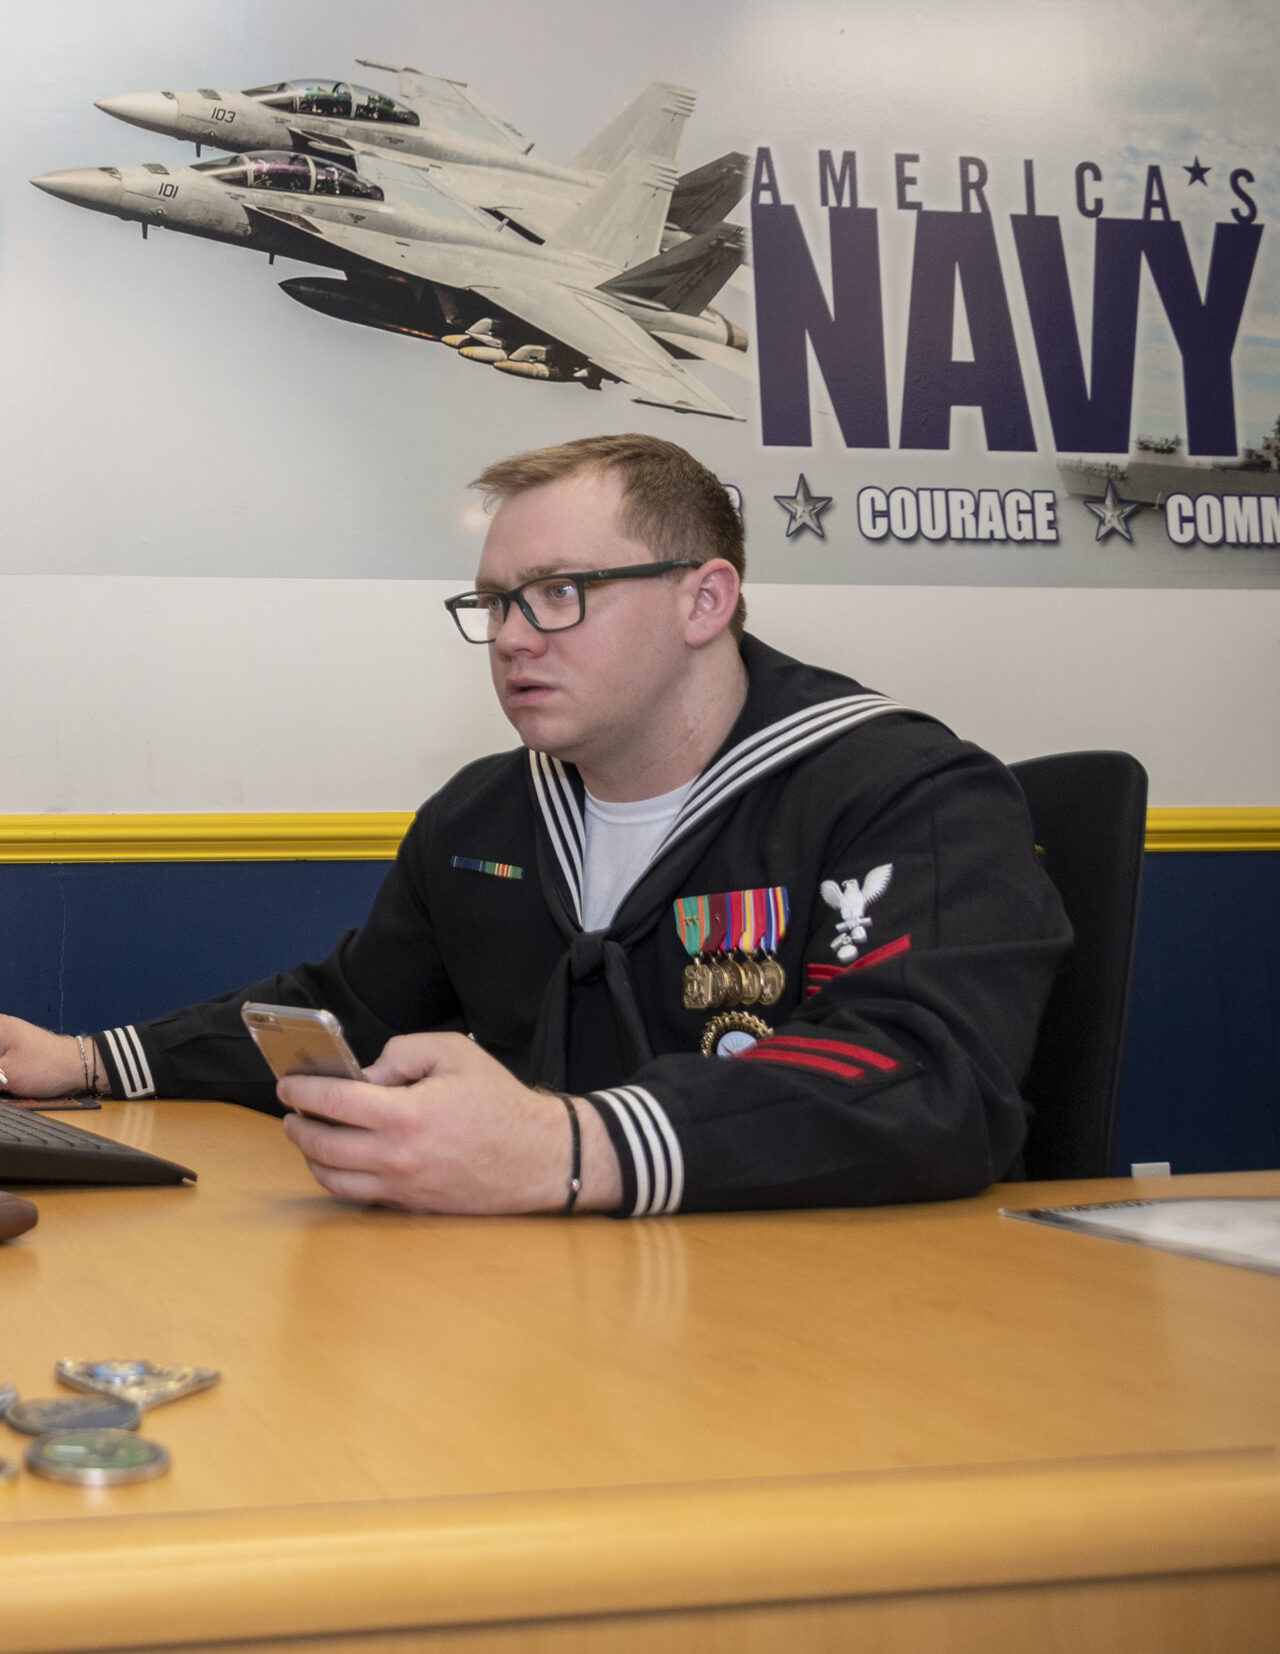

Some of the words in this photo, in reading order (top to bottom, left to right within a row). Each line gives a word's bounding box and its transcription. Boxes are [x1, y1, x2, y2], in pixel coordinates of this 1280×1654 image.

[211, 107, 236, 124] 103
[158, 182, 179, 199] 101
[750, 204, 1265, 457] NAVY
[857, 486, 1058, 542] COURAGE
